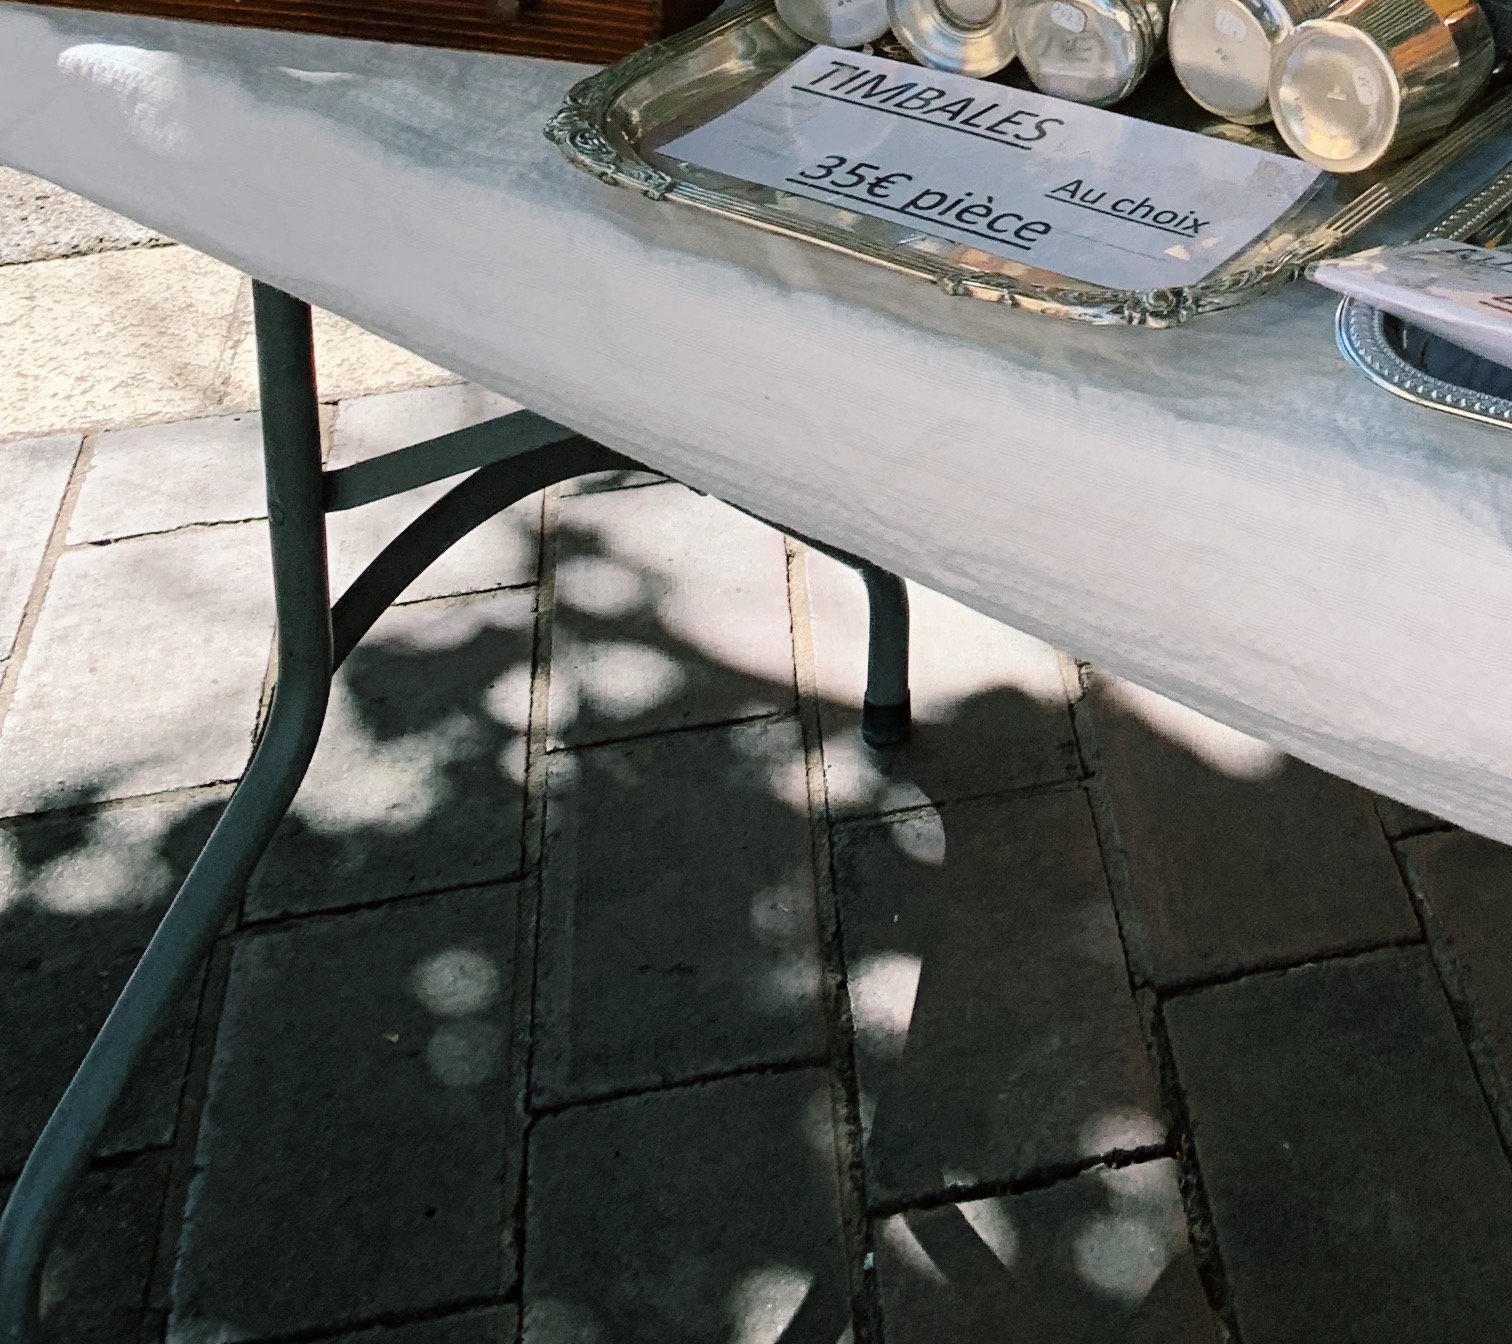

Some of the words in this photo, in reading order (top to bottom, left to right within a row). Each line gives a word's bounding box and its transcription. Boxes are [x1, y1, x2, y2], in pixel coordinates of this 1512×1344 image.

[809, 61, 1064, 142] TIMBALES
[799, 155, 912, 199] 35€
[899, 188, 1052, 243] pièce
[1050, 179, 1107, 205] Au
[1111, 197, 1210, 234] choix
